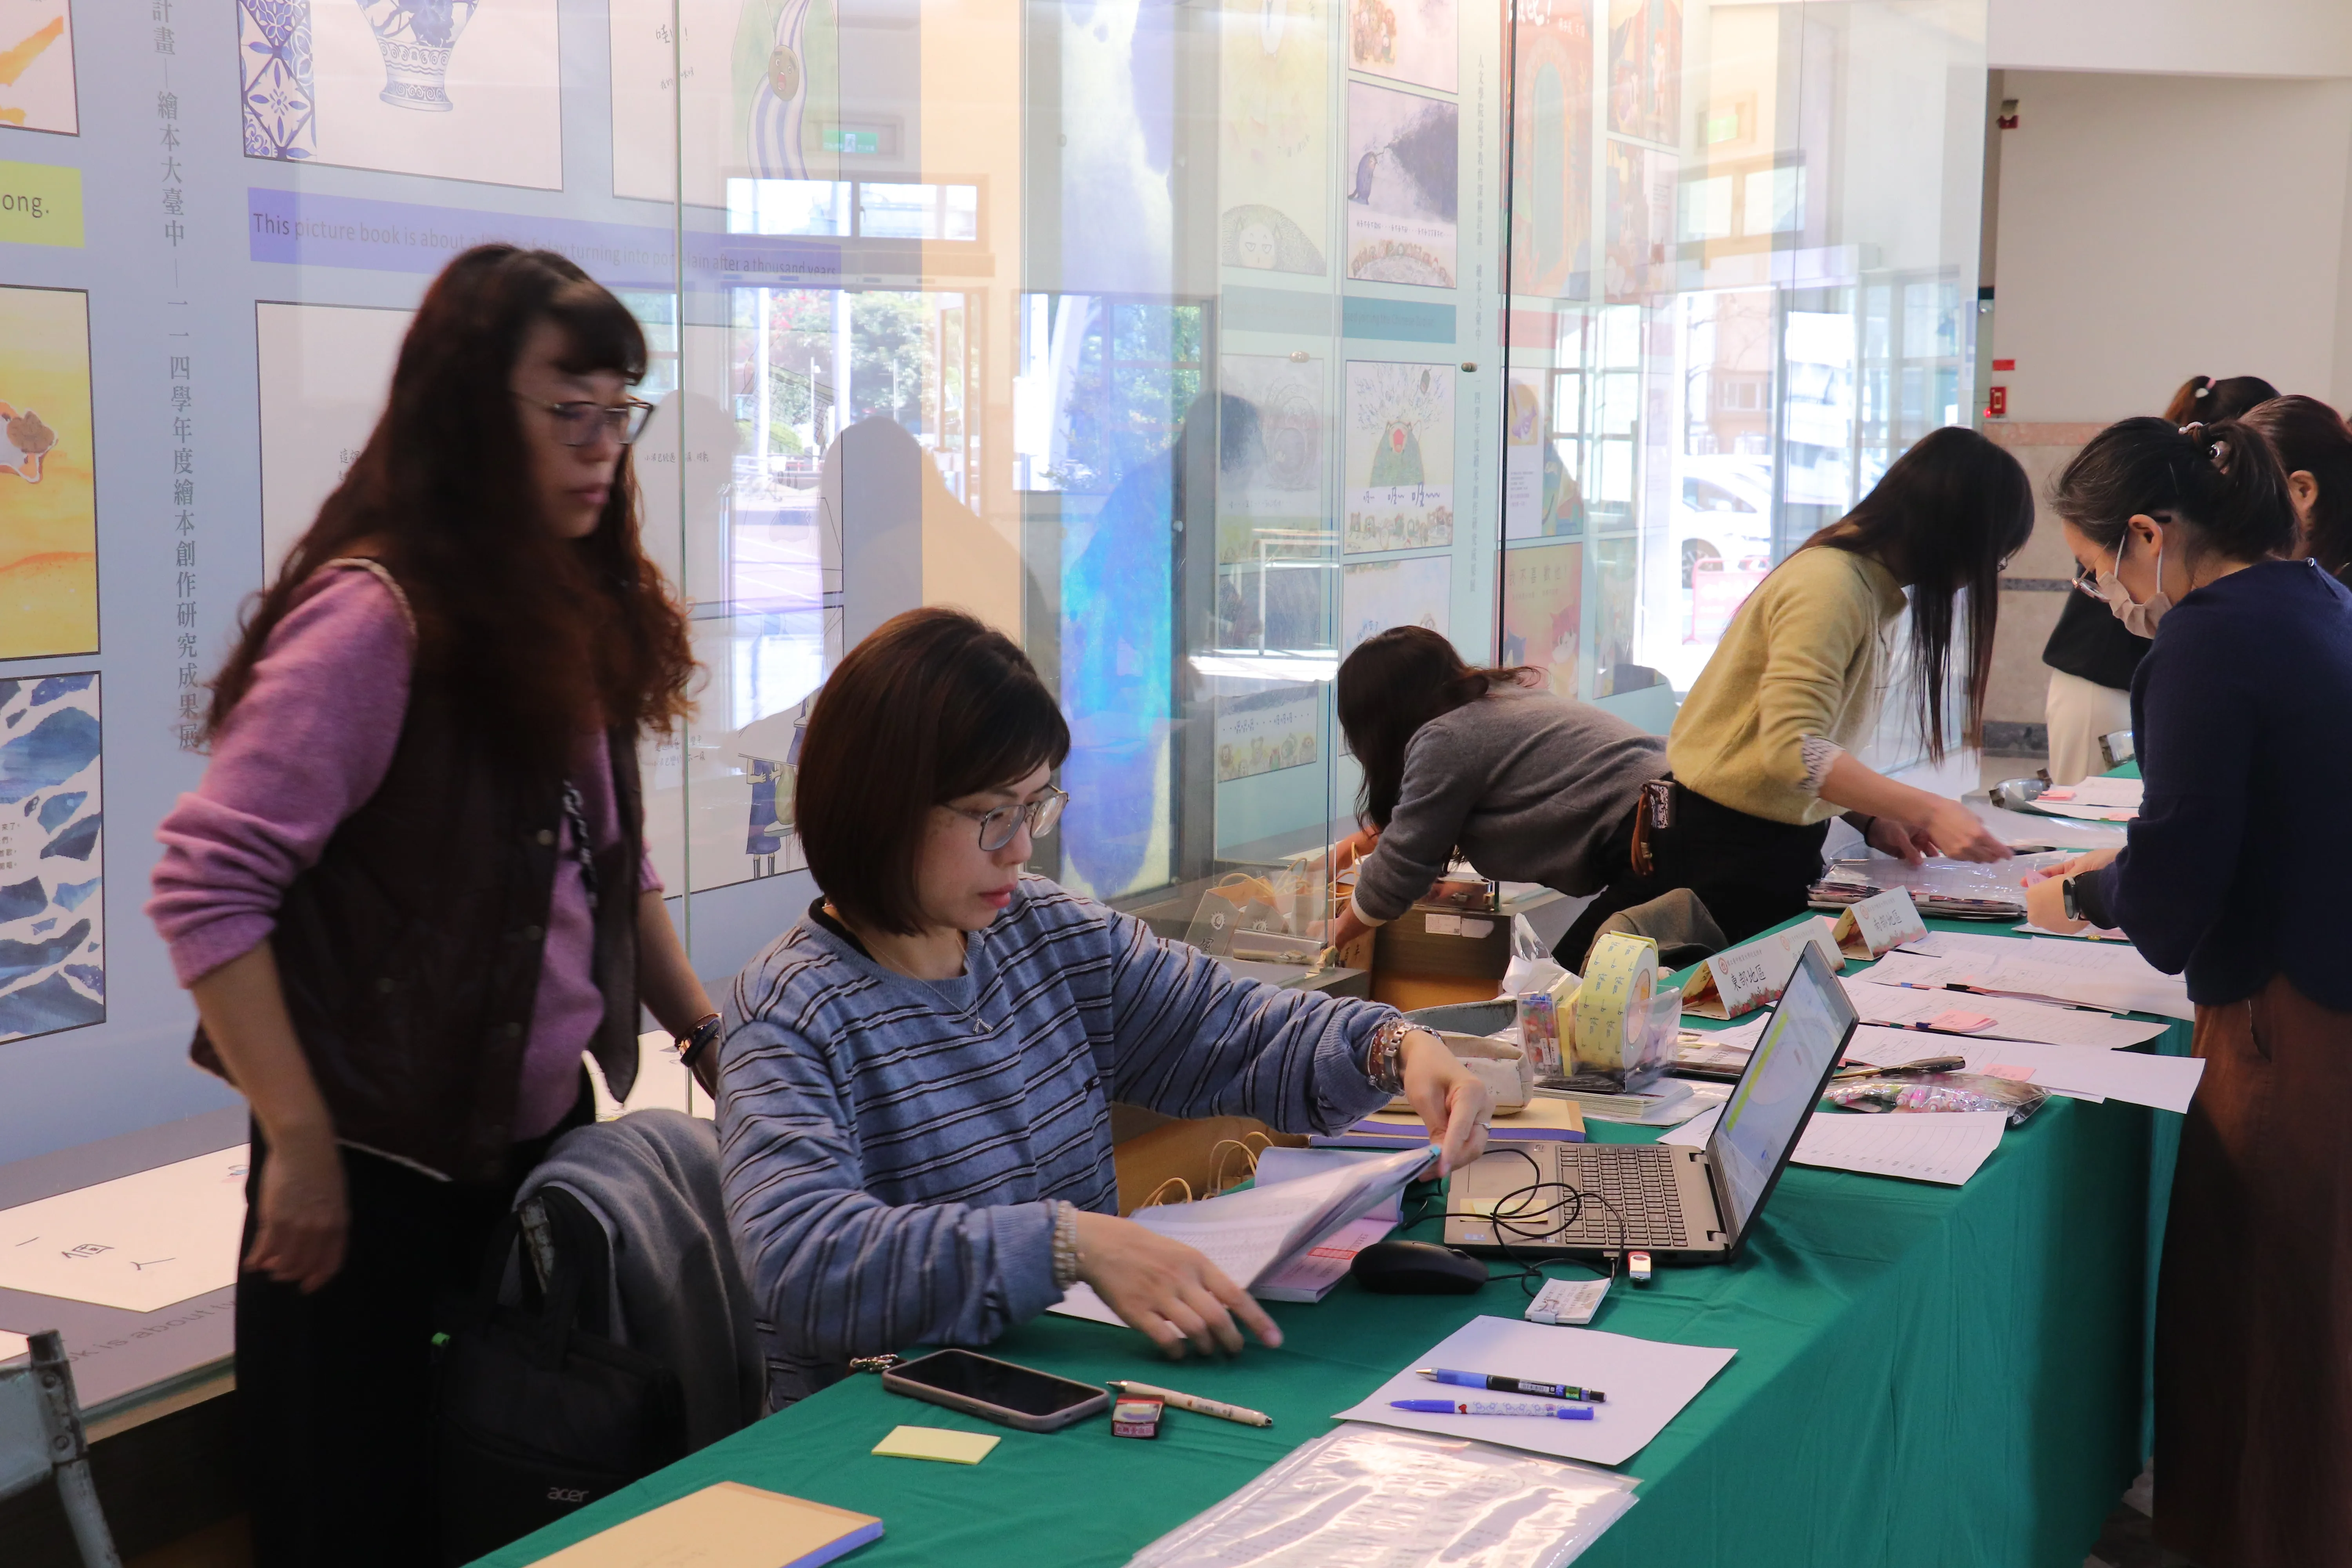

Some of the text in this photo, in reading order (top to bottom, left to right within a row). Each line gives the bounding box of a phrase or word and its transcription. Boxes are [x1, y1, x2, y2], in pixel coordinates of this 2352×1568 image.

[254, 213, 290, 236] This
[295, 220, 355, 241] picture
[360, 222, 400, 245] book
[405, 227, 416, 246] is
[421, 228, 464, 250] about
[570, 244, 620, 266] turning
[623, 246, 649, 265] into
[713, 253, 739, 271] after
[743, 260, 750, 272] a
[753, 257, 805, 276] thousand
[1730, 964, 1766, 992] 東部地區
[130, 1309, 216, 1339] about
[546, 1486, 589, 1503] acer
